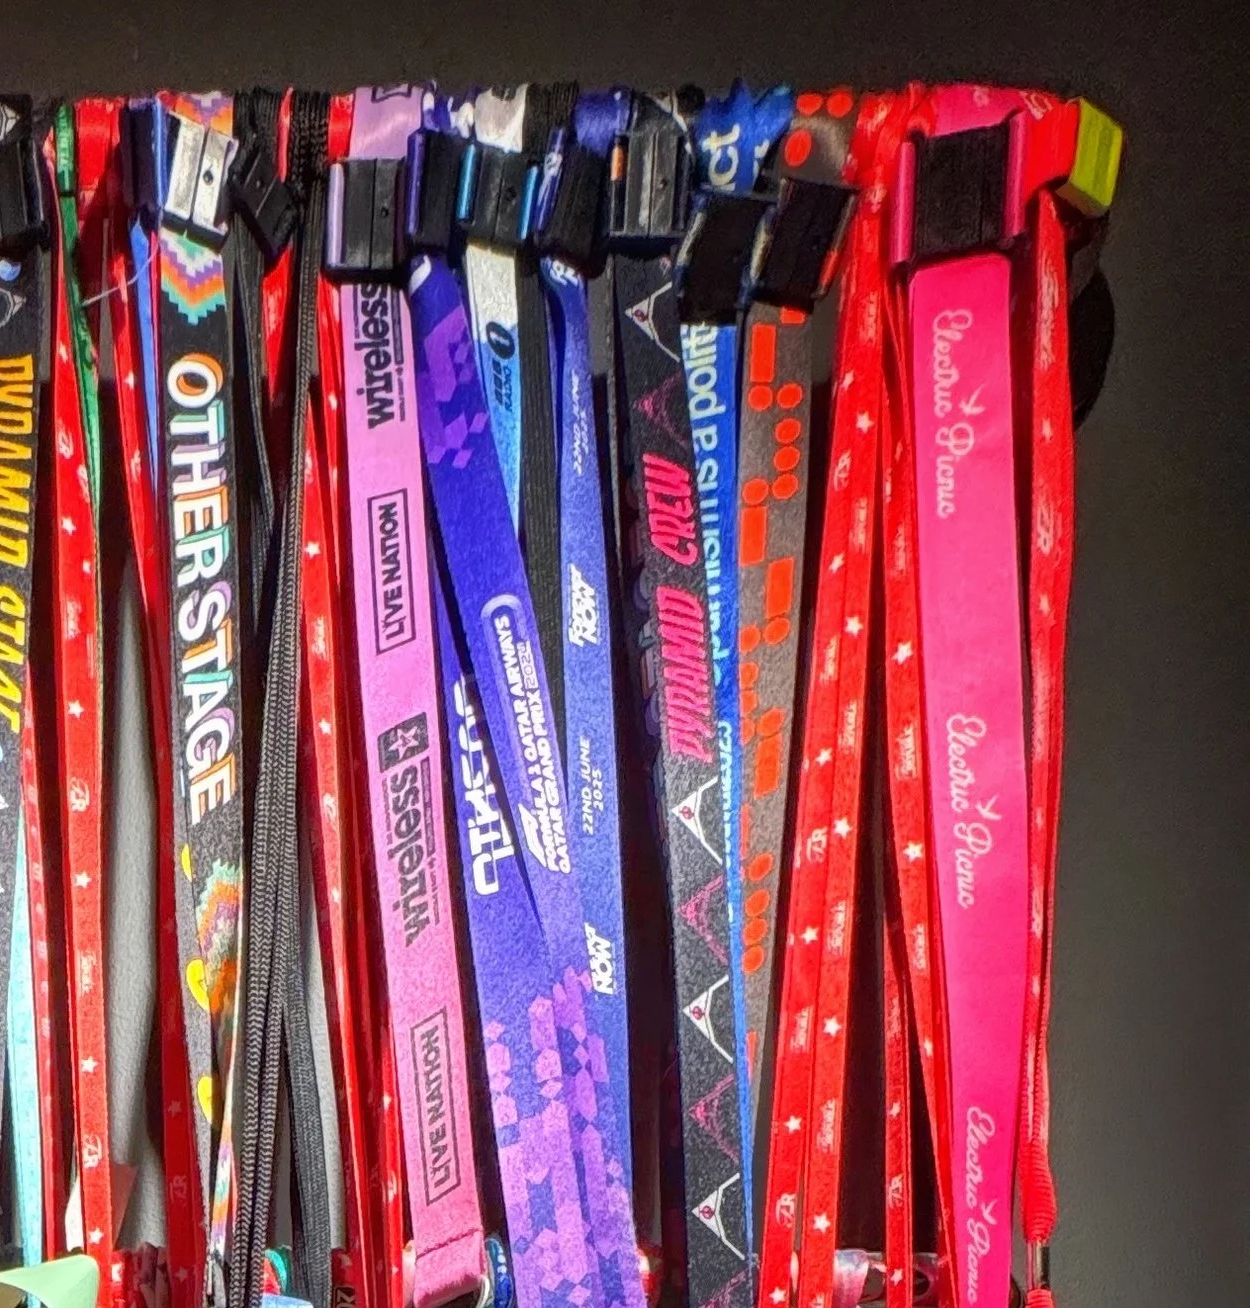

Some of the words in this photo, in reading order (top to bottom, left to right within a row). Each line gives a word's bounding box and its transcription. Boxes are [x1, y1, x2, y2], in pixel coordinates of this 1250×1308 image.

[166, 352, 230, 588] OTHER
[642, 453, 698, 565] CREW
[378, 502, 400, 586] NATION
[381, 588, 405, 638] LIVE
[494, 615, 525, 696] AIRWAYS
[177, 586, 239, 826] STAGE
[655, 585, 714, 763] PYRAMID
[512, 699, 540, 761] QATAR
[579, 737, 591, 783] JUNE
[947, 712, 987, 812] Electric
[389, 766, 430, 946] wireless
[526, 777, 559, 871] FORMULA
[579, 787, 595, 835] 22ND
[955, 813, 992, 909] Picnic
[422, 1025, 441, 1129] NATION
[428, 1130, 451, 1189] LIVE
